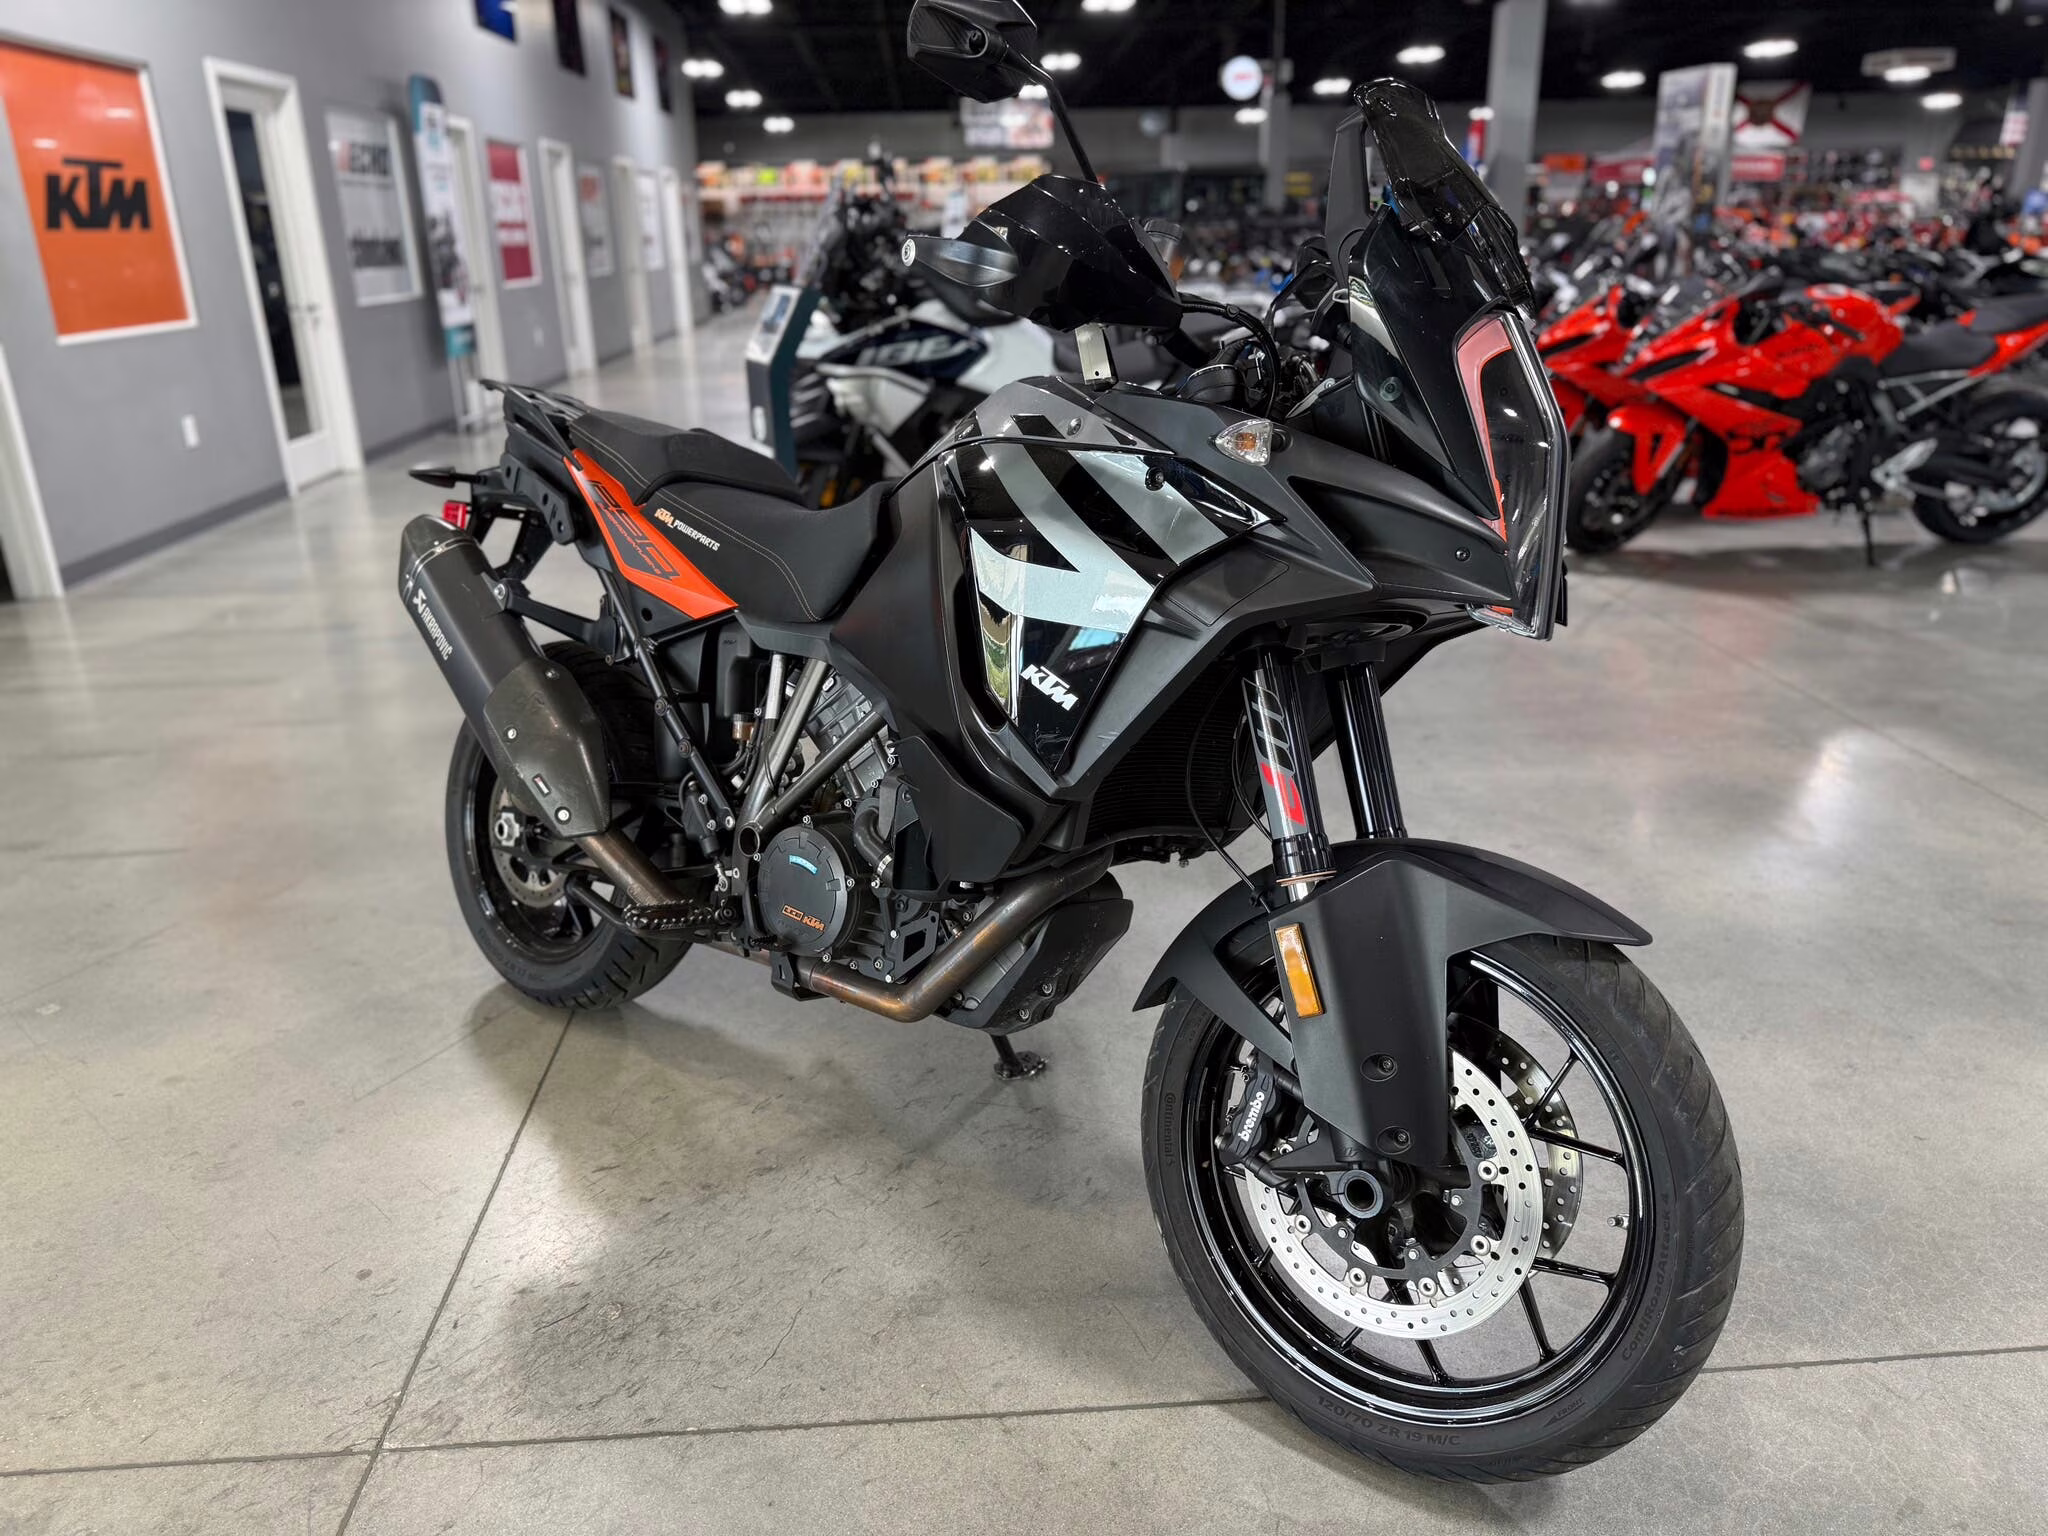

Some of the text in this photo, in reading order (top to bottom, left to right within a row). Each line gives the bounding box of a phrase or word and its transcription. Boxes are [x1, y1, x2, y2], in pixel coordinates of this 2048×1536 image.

[45, 156, 152, 231] KTM
[654, 507, 721, 551] KTM POWERPARTS
[1020, 663, 1079, 711] KTM
[803, 915, 825, 931] KTM
[1164, 1092, 1176, 1157] Continental
[1238, 1091, 1265, 1142] brembo
[1621, 1209, 1672, 1361] ContiRoadAttack
[1317, 1396, 1461, 1447] 120/70 ZR 19 M/C
